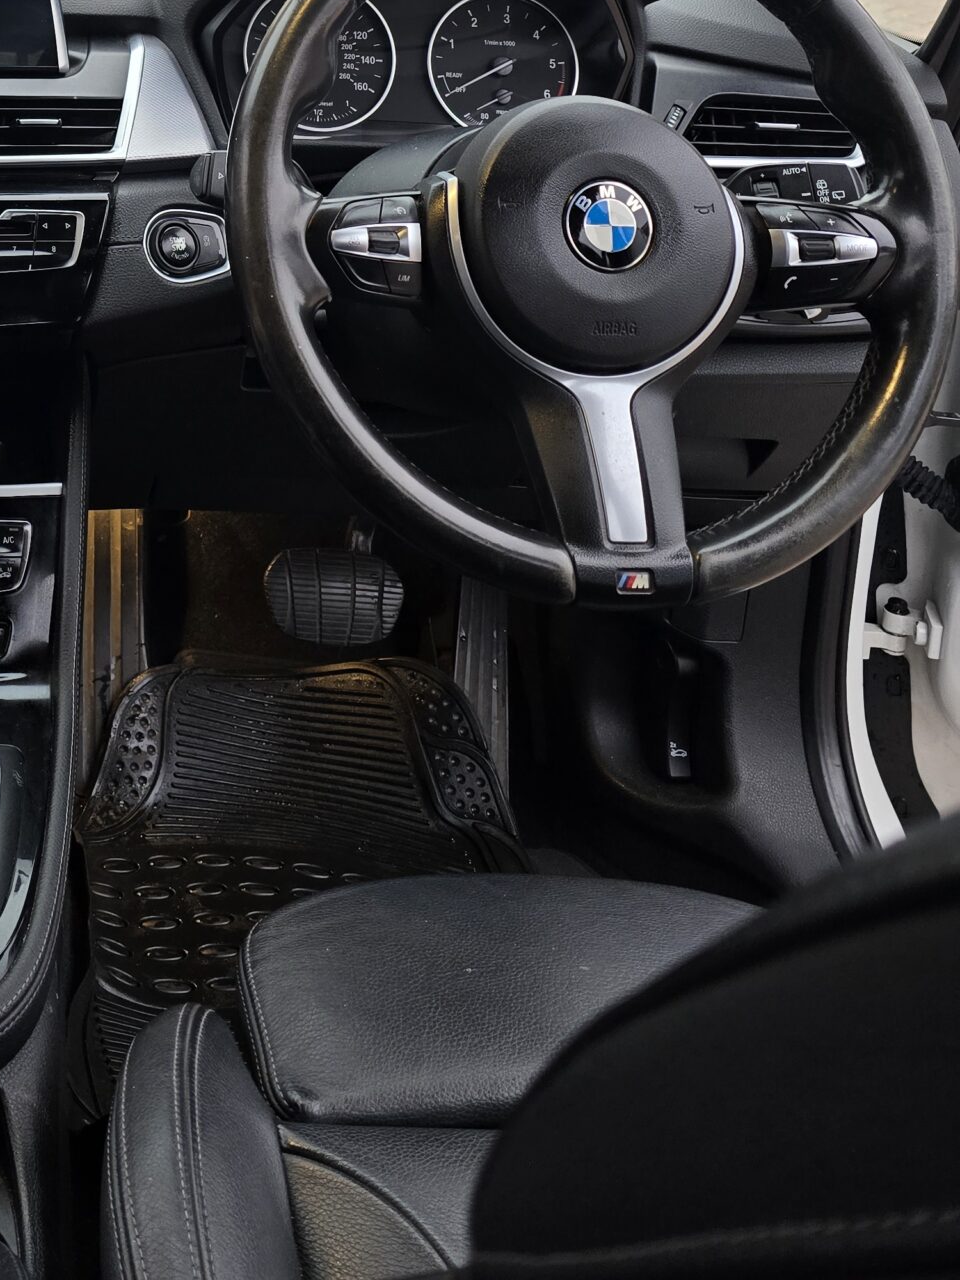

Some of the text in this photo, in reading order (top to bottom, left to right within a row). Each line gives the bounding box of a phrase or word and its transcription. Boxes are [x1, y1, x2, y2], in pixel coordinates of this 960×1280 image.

[471, 17, 478, 28] 2
[504, 14, 510, 24] 3
[353, 31, 368, 40] 120
[533, 30, 540, 40] 4
[449, 38, 455, 49] 1
[361, 56, 376, 65] 140
[549, 59, 556, 69] 5
[353, 82, 368, 91] 160
[544, 89, 551, 99] 6
[480, 112, 489, 120] 80
[782, 168, 800, 176] AUTO
[575, 185, 642, 212] BMW
[591, 321, 638, 336] AIRBAG
[3, 536, 14, 544] A/C
